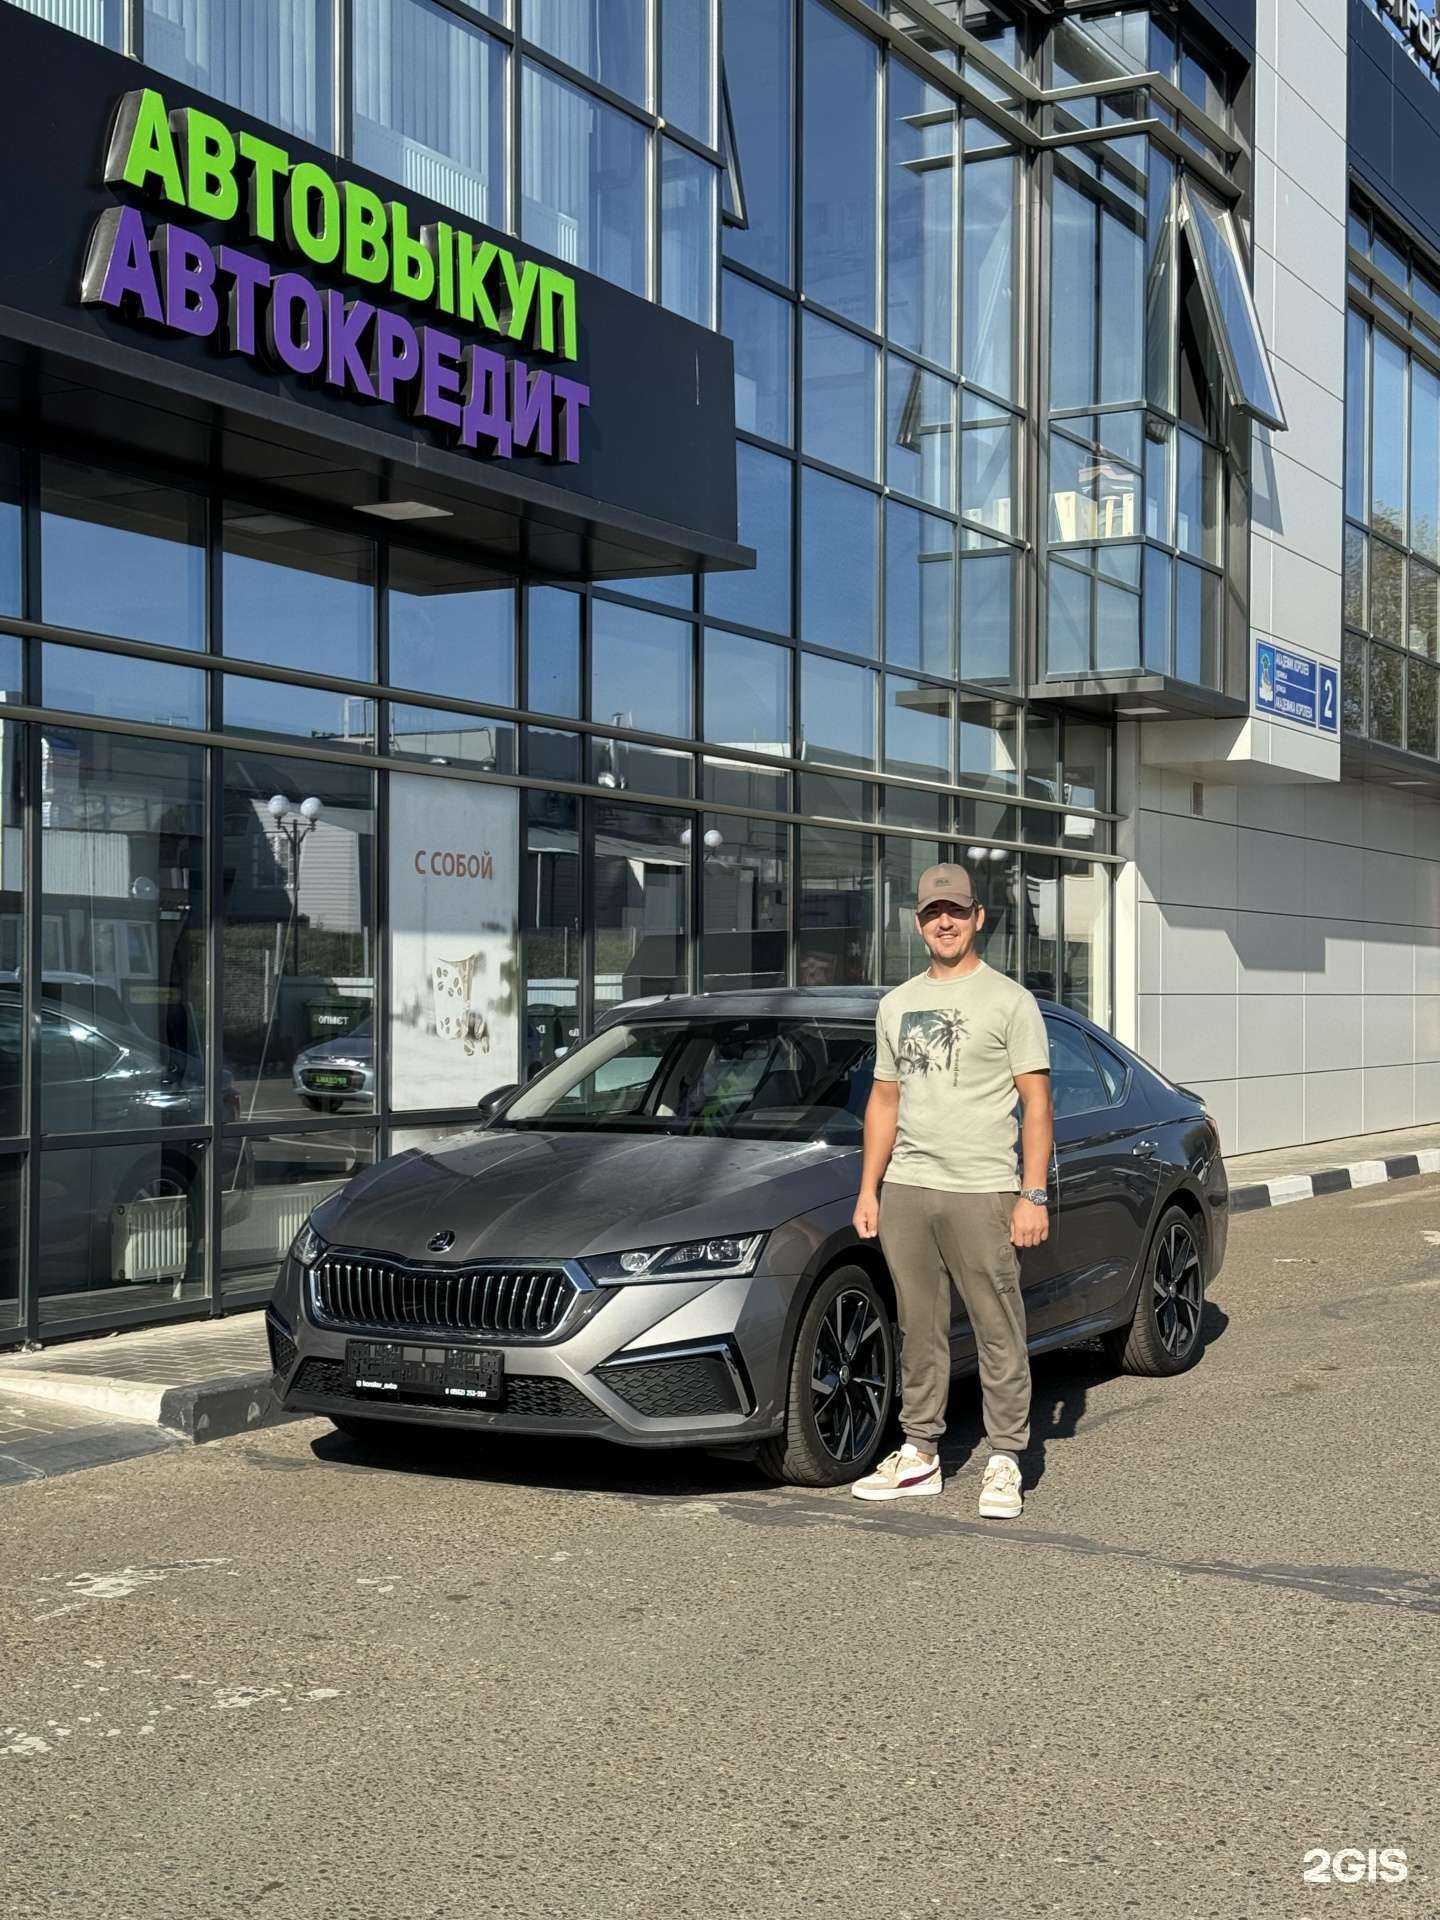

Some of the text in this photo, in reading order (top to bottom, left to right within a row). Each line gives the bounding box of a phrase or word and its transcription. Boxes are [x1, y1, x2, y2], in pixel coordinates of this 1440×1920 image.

[122, 87, 578, 362] АВТОВЫКУП
[100, 204, 591, 465] АВТОКРЕДИТ
[1324, 679, 1333, 718] 2
[414, 850, 493, 880] С СОБОЙ
